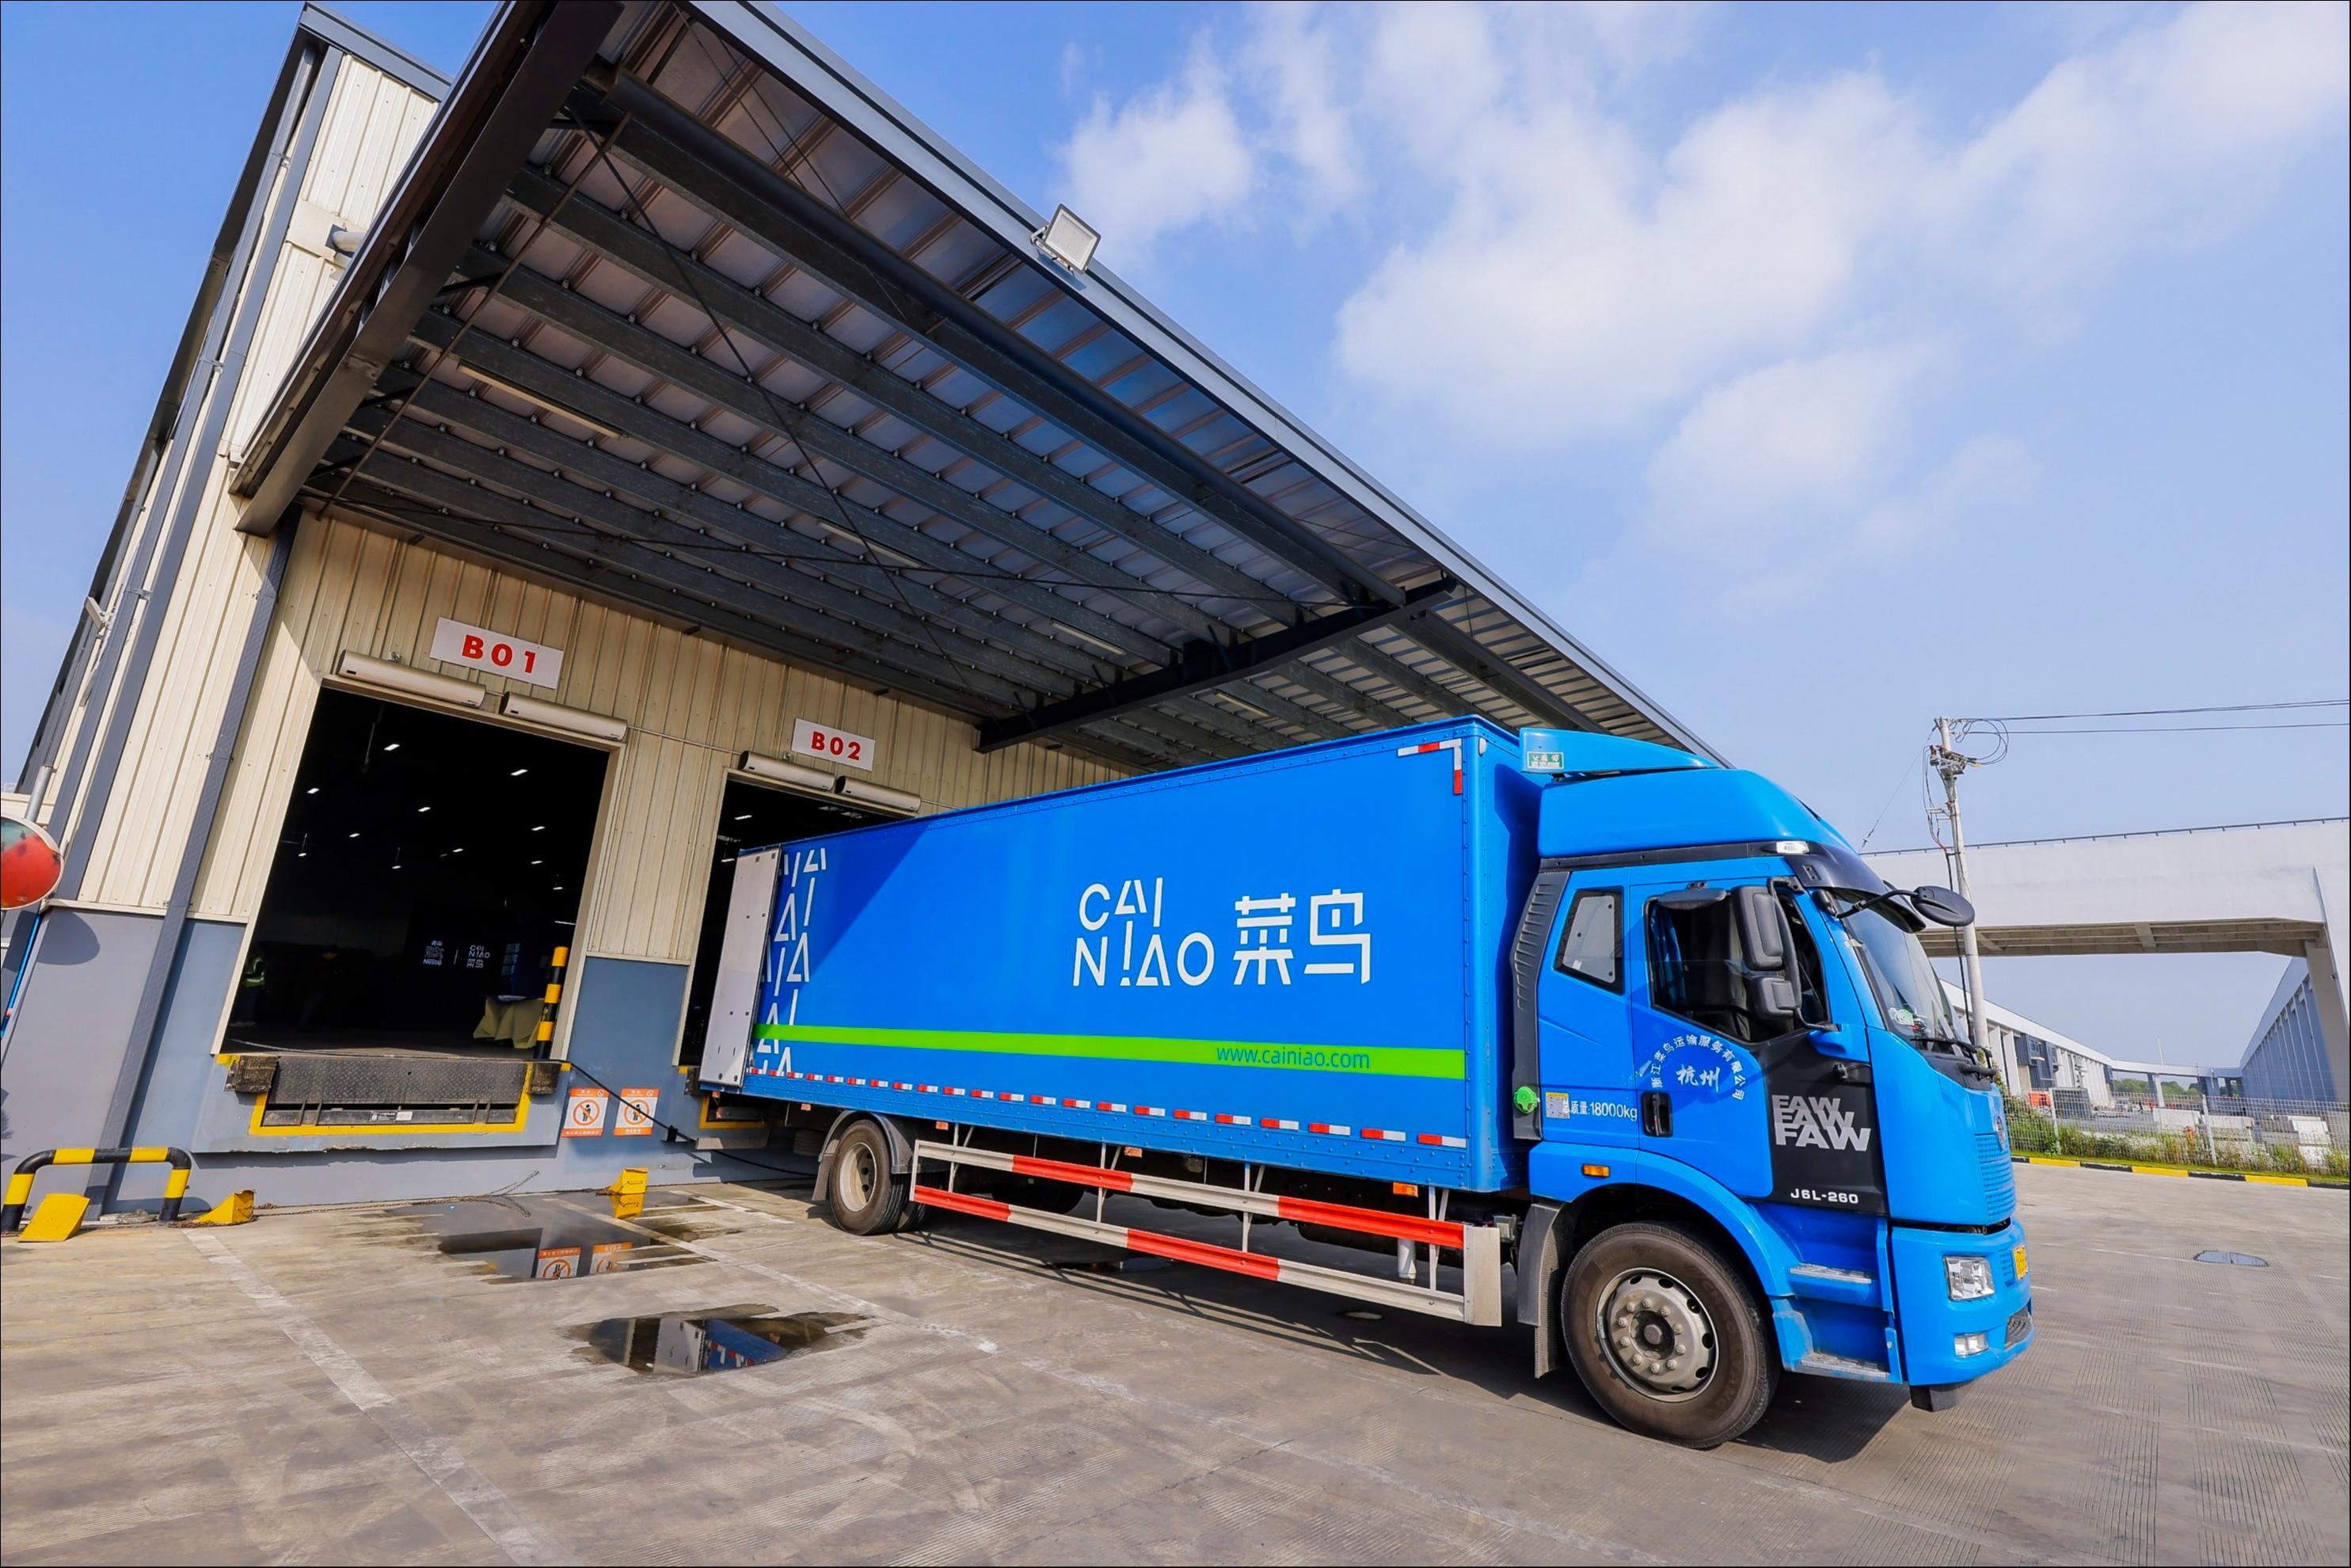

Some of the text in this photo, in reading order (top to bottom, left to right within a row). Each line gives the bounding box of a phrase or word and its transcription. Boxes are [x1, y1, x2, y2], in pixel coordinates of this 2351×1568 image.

[462, 634, 536, 674] B01
[811, 731, 862, 761] B02
[1078, 877, 1164, 931] CAI
[1232, 888, 1371, 985] 菜鸟
[1216, 1046, 1370, 1069] www.cainiao.com
[1675, 1064, 1721, 1093] 杭州
[1775, 1122, 1871, 1151] FAW
[1790, 1188, 1859, 1205] J6L-260
